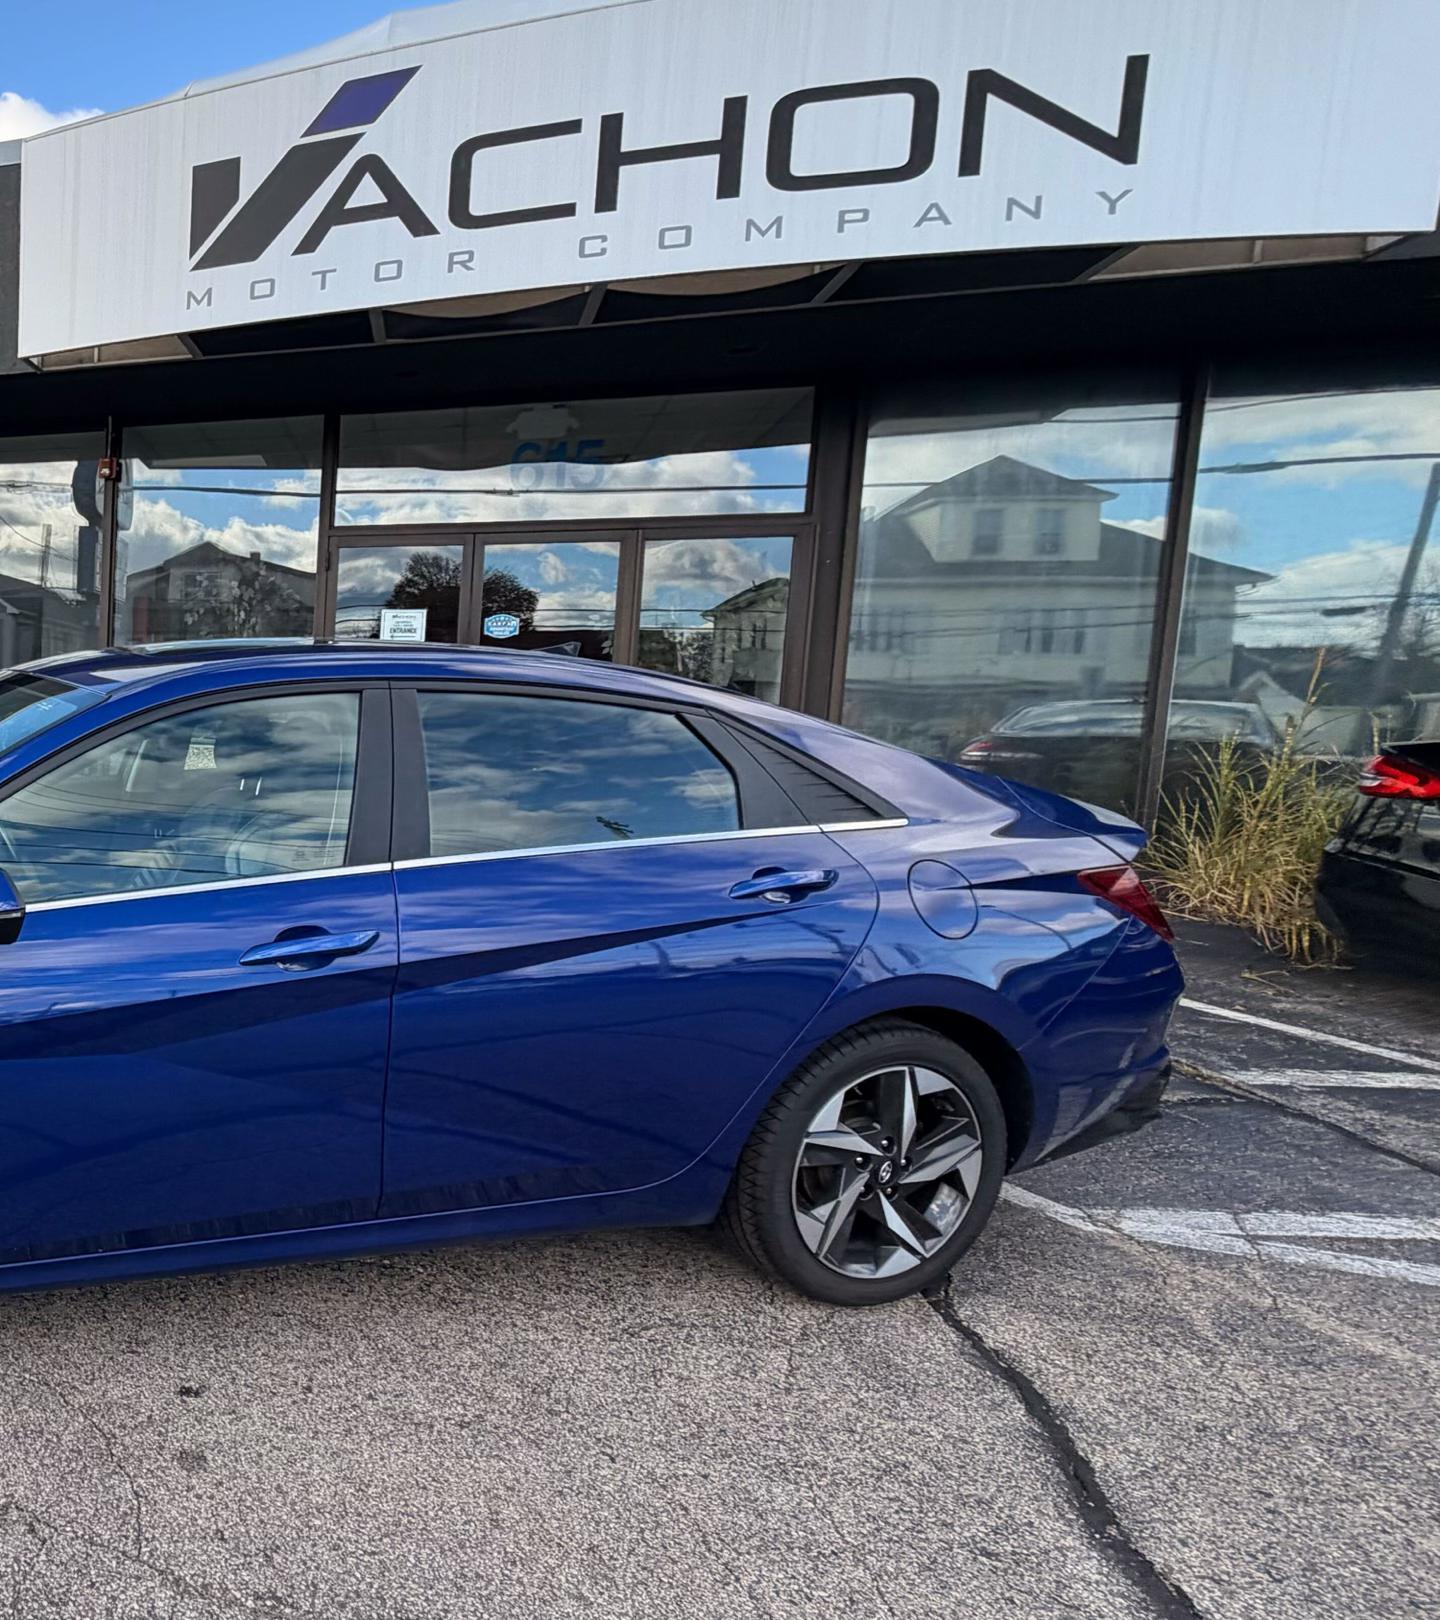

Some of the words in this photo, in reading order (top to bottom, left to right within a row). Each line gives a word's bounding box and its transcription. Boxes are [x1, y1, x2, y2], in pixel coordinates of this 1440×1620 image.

[188, 54, 1150, 272] VACHON
[186, 250, 475, 310] MOTOR
[578, 189, 1133, 258] COMPANY
[510, 439, 606, 490] 615
